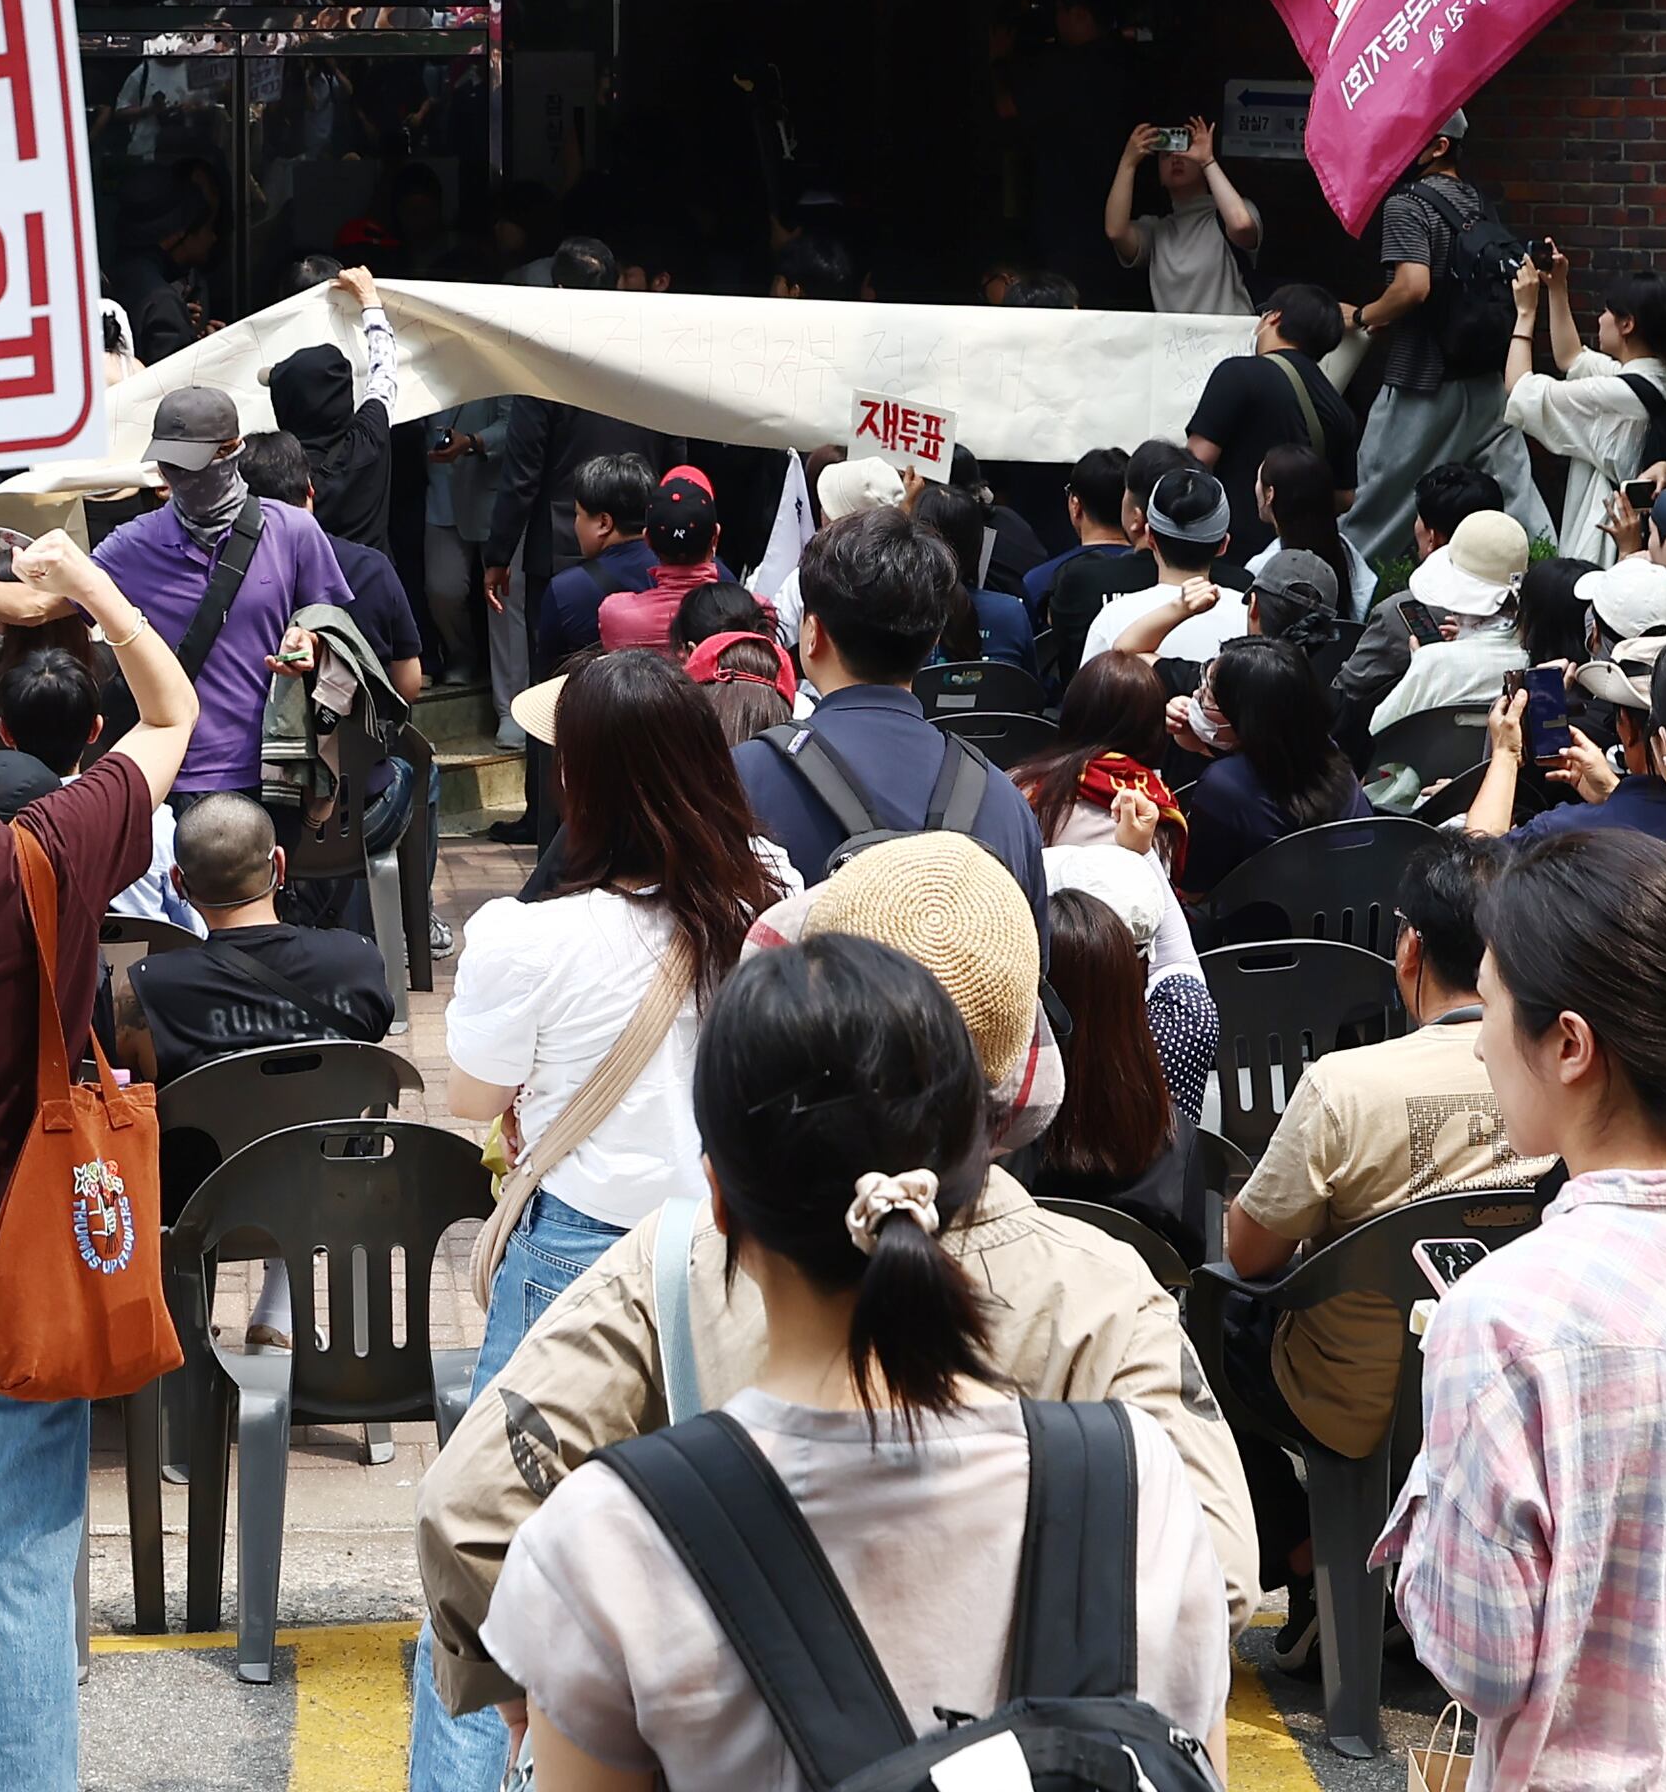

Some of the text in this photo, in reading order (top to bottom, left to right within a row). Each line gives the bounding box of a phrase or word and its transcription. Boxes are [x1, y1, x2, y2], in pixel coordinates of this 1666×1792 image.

[1238, 115, 1270, 132] 잠실7
[856, 399, 947, 463] 재투표
[72, 1196, 135, 1274] THUMBS UP FLOWERS
